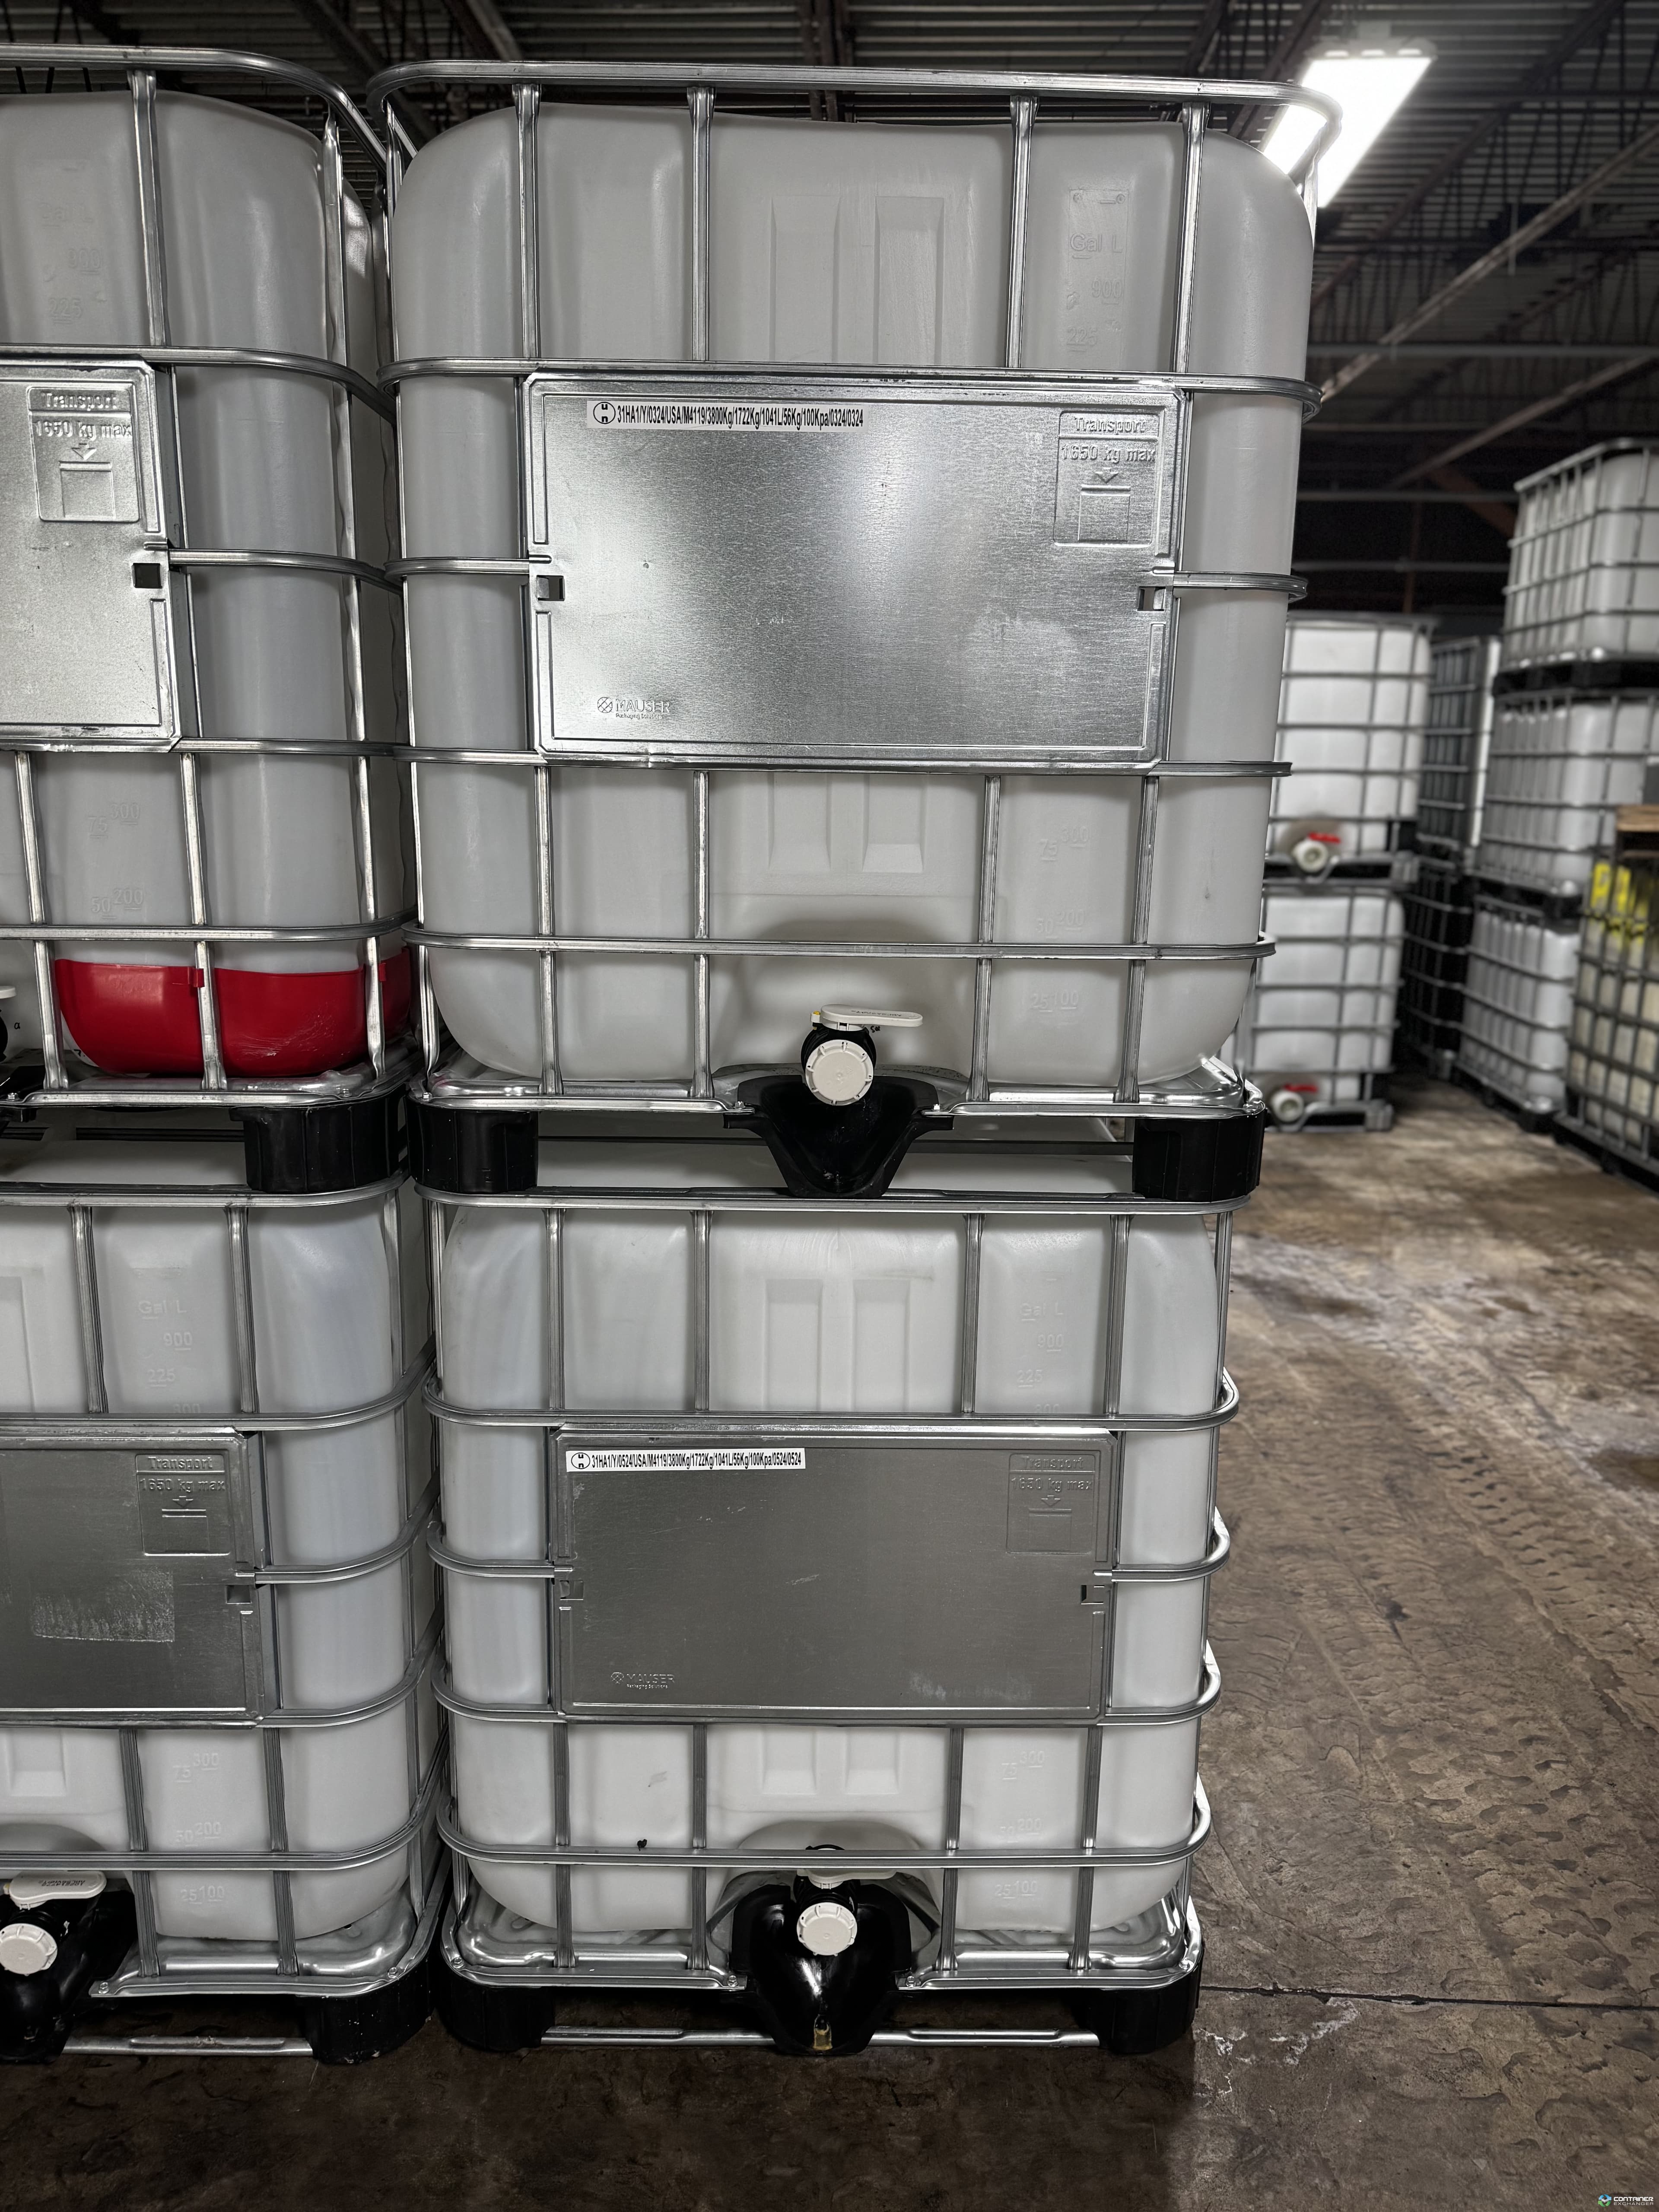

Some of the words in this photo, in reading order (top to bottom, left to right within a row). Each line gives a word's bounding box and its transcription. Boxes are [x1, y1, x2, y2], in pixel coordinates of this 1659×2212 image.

[1070, 232, 1103, 253] Gal
[1112, 235, 1123, 254] L
[67, 248, 102, 270] 900
[1091, 278, 1123, 299] 900
[48, 297, 83, 319] 225
[1066, 326, 1098, 346] 225
[42, 391, 117, 411] Transport
[617, 405, 864, 430] 31HA1/Y/0324/USA/M4119/3800Kg/1722Kg/1041L/56Kg/100Kpa/0324/0324
[32, 421, 73, 437] 1650
[77, 421, 97, 440] kg
[101, 424, 132, 438] max
[1074, 417, 1146, 435] Transport
[1061, 443, 1098, 461] 1650
[1103, 444, 1120, 464] kg
[1126, 448, 1155, 462] max
[615, 699, 671, 713] MAUSER
[109, 802, 140, 820] 300
[87, 815, 108, 833] 75
[1061, 825, 1090, 843] 300
[1039, 838, 1058, 857] 75
[113, 888, 143, 906] 200
[91, 896, 111, 914] 50
[1057, 908, 1085, 926] 200
[1036, 917, 1054, 934] 50
[1030, 992, 1049, 1009] 25
[1050, 989, 1079, 1006] 100
[138, 1300, 167, 1314] Gal
[176, 1300, 187, 1313] L
[1020, 1303, 1046, 1316] Gal
[1055, 1302, 1064, 1315] L
[163, 1332, 193, 1347] 900
[1037, 1333, 1064, 1348] 900
[147, 1368, 175, 1382] 225
[1017, 1369, 1042, 1382] 225
[148, 1456, 213, 1470] Transport
[591, 1452, 801, 1469] 31HA1/Y/0524/USA/M4119/3800Kg/1722Kg/1041L/56Kg/100Kpa/0524/0524
[1022, 1456, 1084, 1469] Transport
[140, 1478, 173, 1491] 1650
[178, 1478, 194, 1493] kg
[197, 1481, 226, 1491] max
[1011, 1477, 1042, 1490] 1650
[1048, 1478, 1063, 1492] kg
[1067, 1480, 1092, 1490] max
[626, 1673, 675, 1683] MAUSER
[193, 1753, 219, 1767] 300
[1020, 1750, 1045, 1764] 300
[173, 1764, 191, 1779] 75
[1001, 1762, 1017, 1776] 75
[195, 1821, 221, 1836] 200
[1017, 1818, 1042, 1831] 200
[175, 1829, 194, 1843] 50
[199, 1885, 225, 1898] 100
[995, 1883, 1011, 1897] 25
[1014, 1880, 1038, 1893] 100
[181, 1888, 197, 1901] 25
